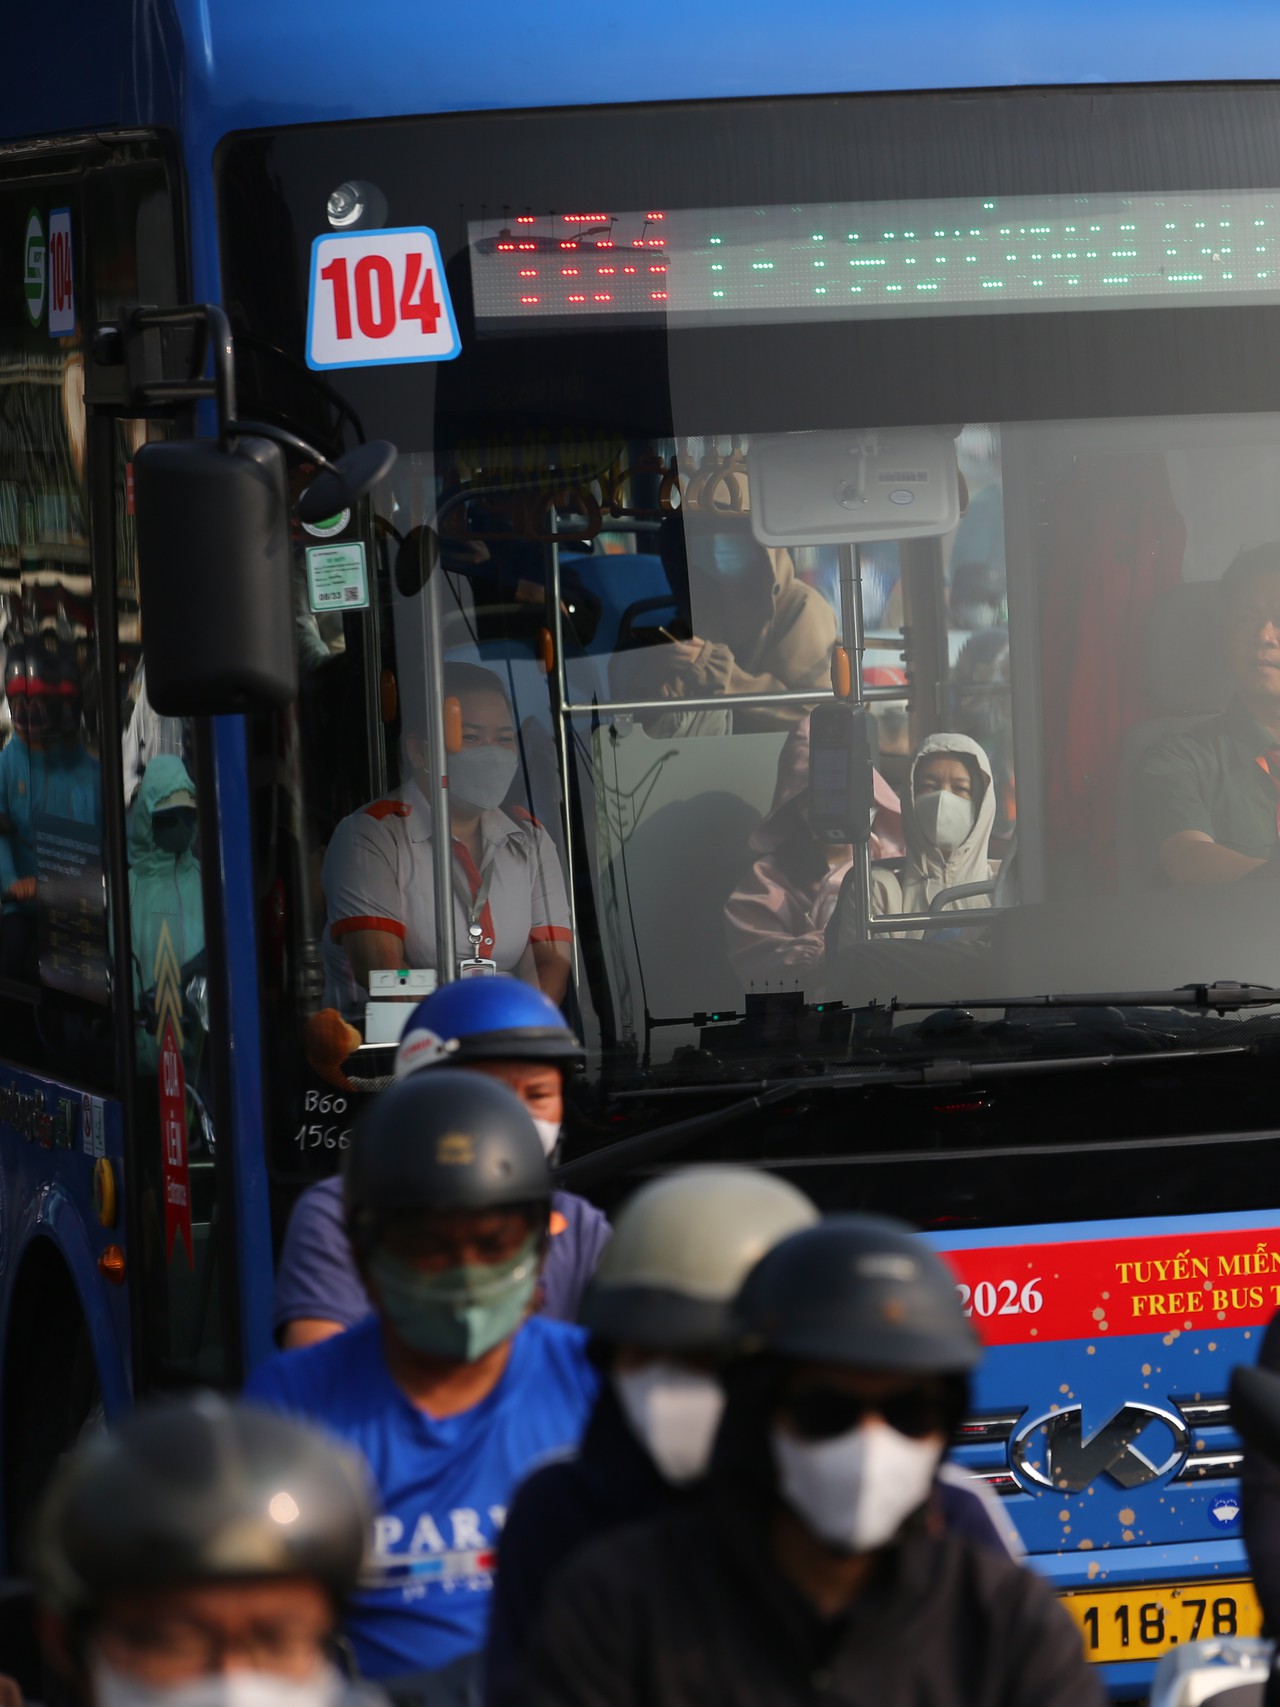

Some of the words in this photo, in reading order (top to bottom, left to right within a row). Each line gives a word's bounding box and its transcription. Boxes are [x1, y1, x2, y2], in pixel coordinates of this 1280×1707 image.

[50, 231, 72, 312] 104
[321, 253, 441, 340] 104
[305, 1090, 348, 1114] B60
[294, 1124, 353, 1150] 1566
[1115, 1248, 1210, 1284] TUYẾN
[954, 1277, 1043, 1317] 2026
[1131, 1291, 1204, 1317] FREE
[1211, 1286, 1264, 1311] BUS
[1084, 1597, 1238, 1651] 118.78
